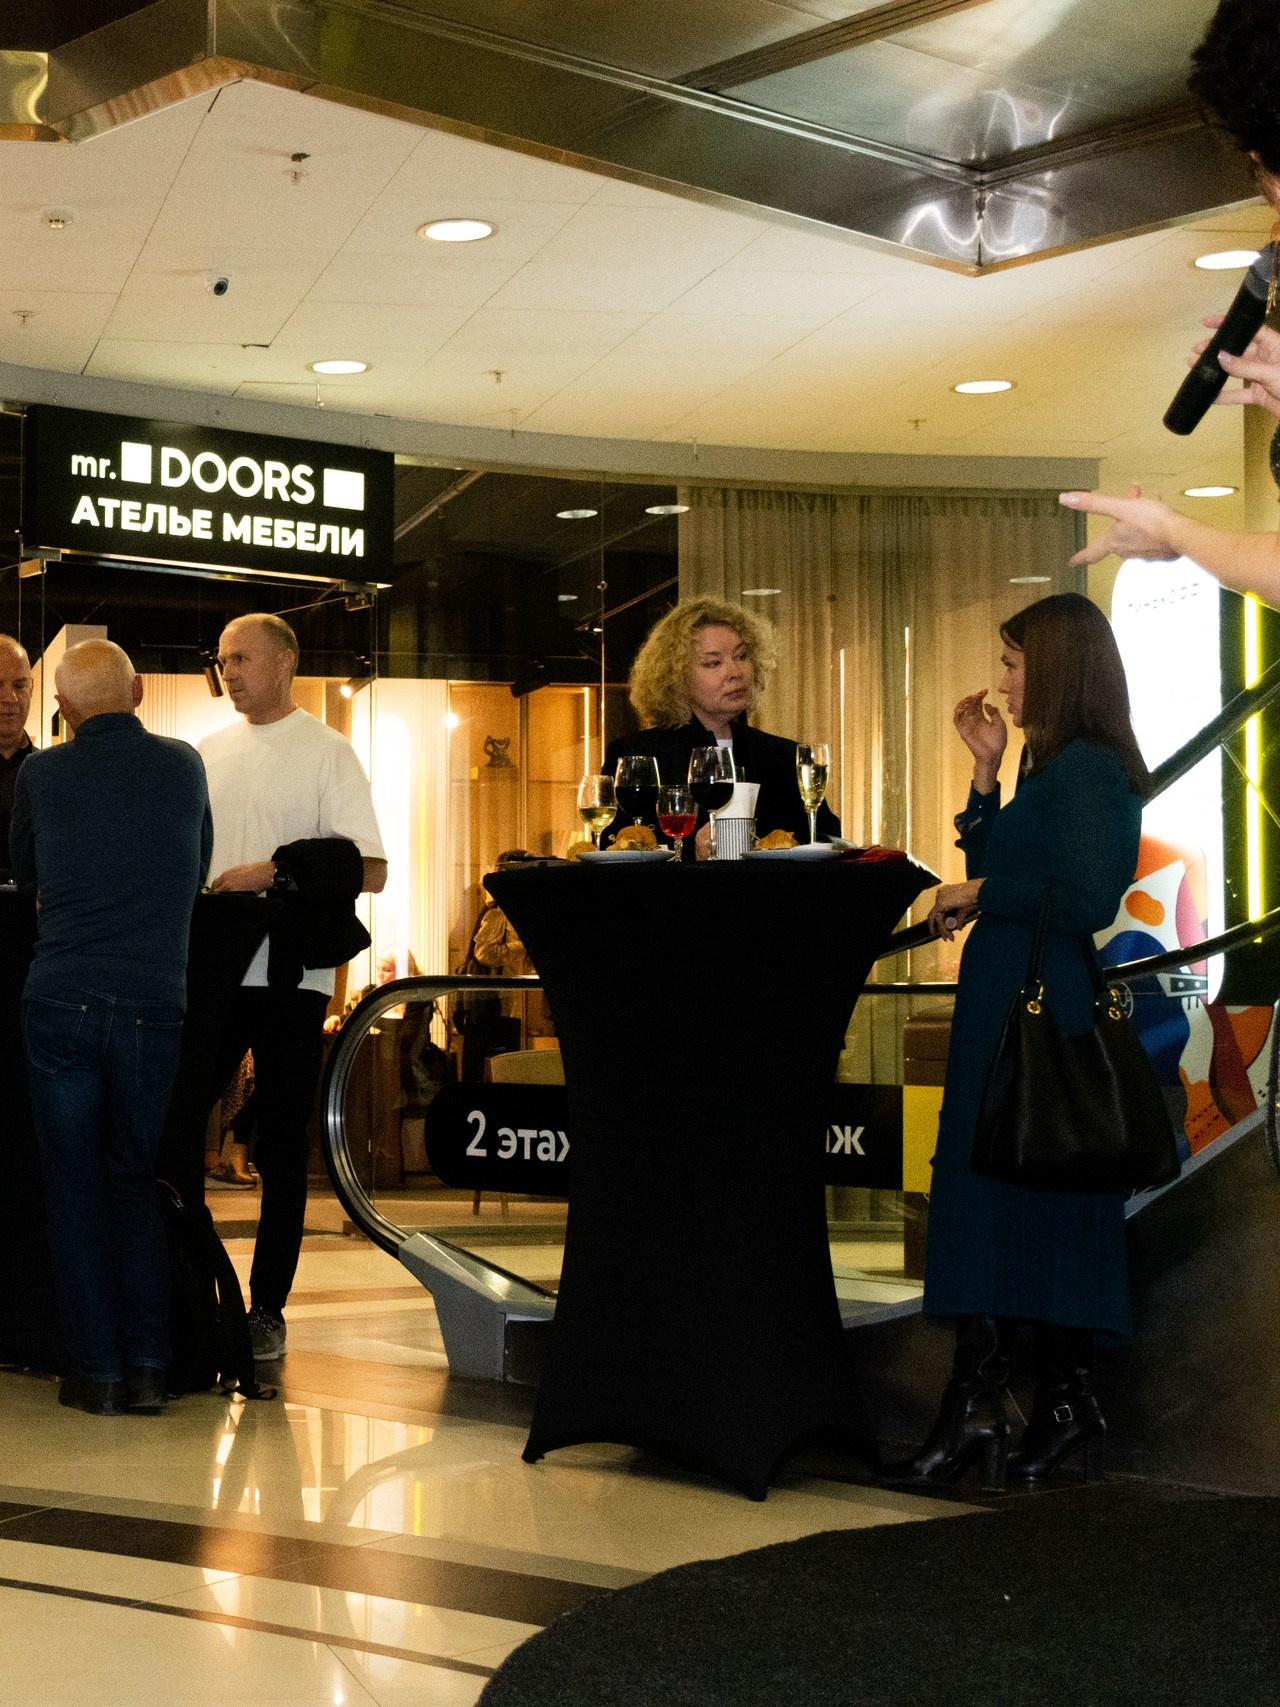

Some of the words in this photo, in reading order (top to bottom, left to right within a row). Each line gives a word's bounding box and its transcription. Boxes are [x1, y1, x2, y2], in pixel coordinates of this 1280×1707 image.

[71, 454, 117, 480] mr.
[160, 446, 316, 505] DOORS
[71, 495, 213, 540] АТЕЛЬЕ
[222, 512, 365, 558] МЕБЕЛИ
[465, 1109, 488, 1157] 2
